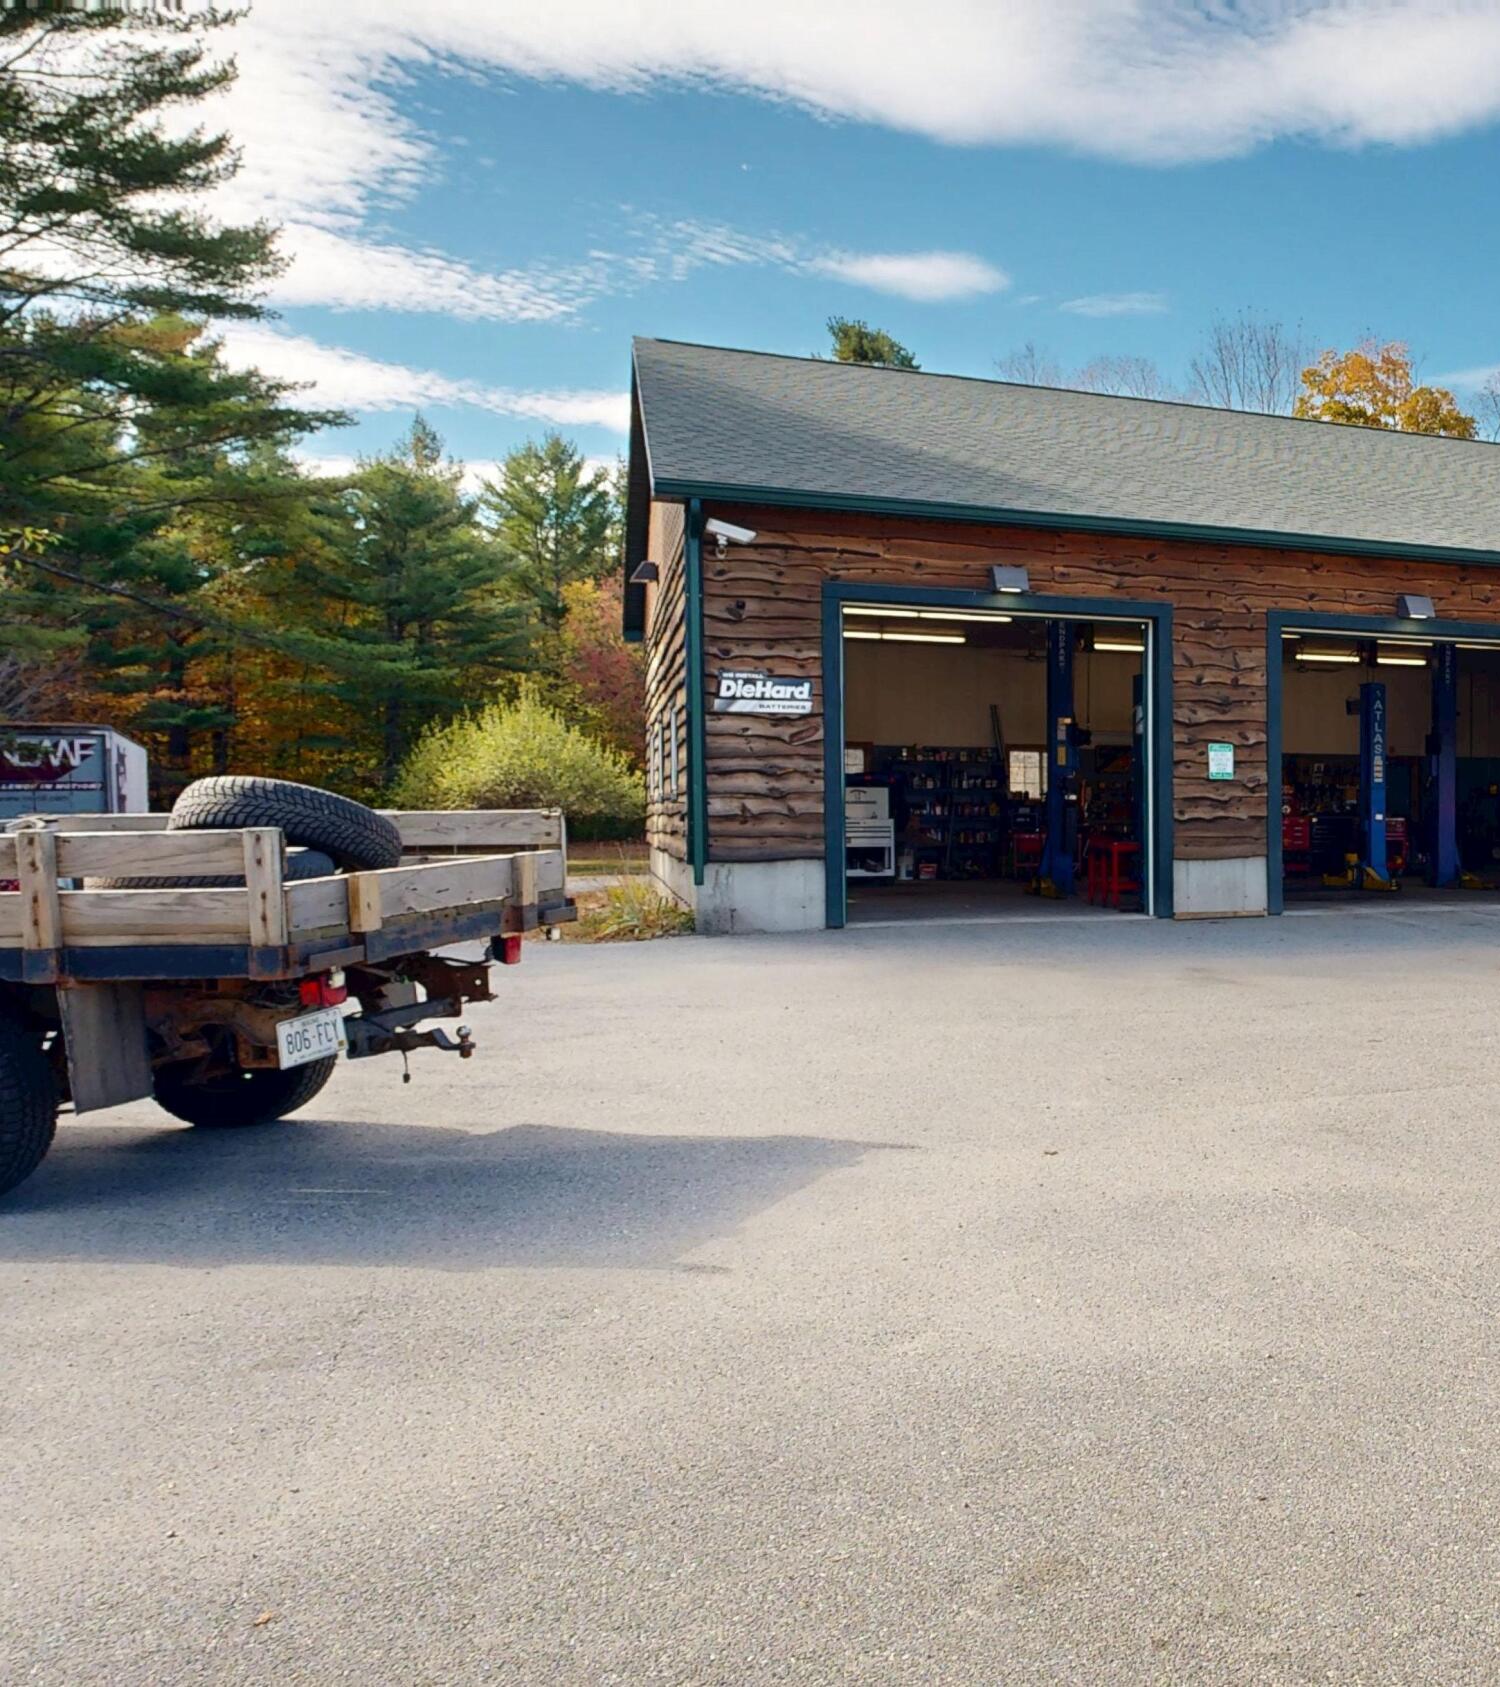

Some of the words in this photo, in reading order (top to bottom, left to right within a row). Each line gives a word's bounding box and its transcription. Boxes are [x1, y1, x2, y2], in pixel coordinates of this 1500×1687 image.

[719, 679, 811, 700] DieHard
[1373, 699, 1384, 754] ATLAS
[286, 1019, 340, 1055] 806-FCY
